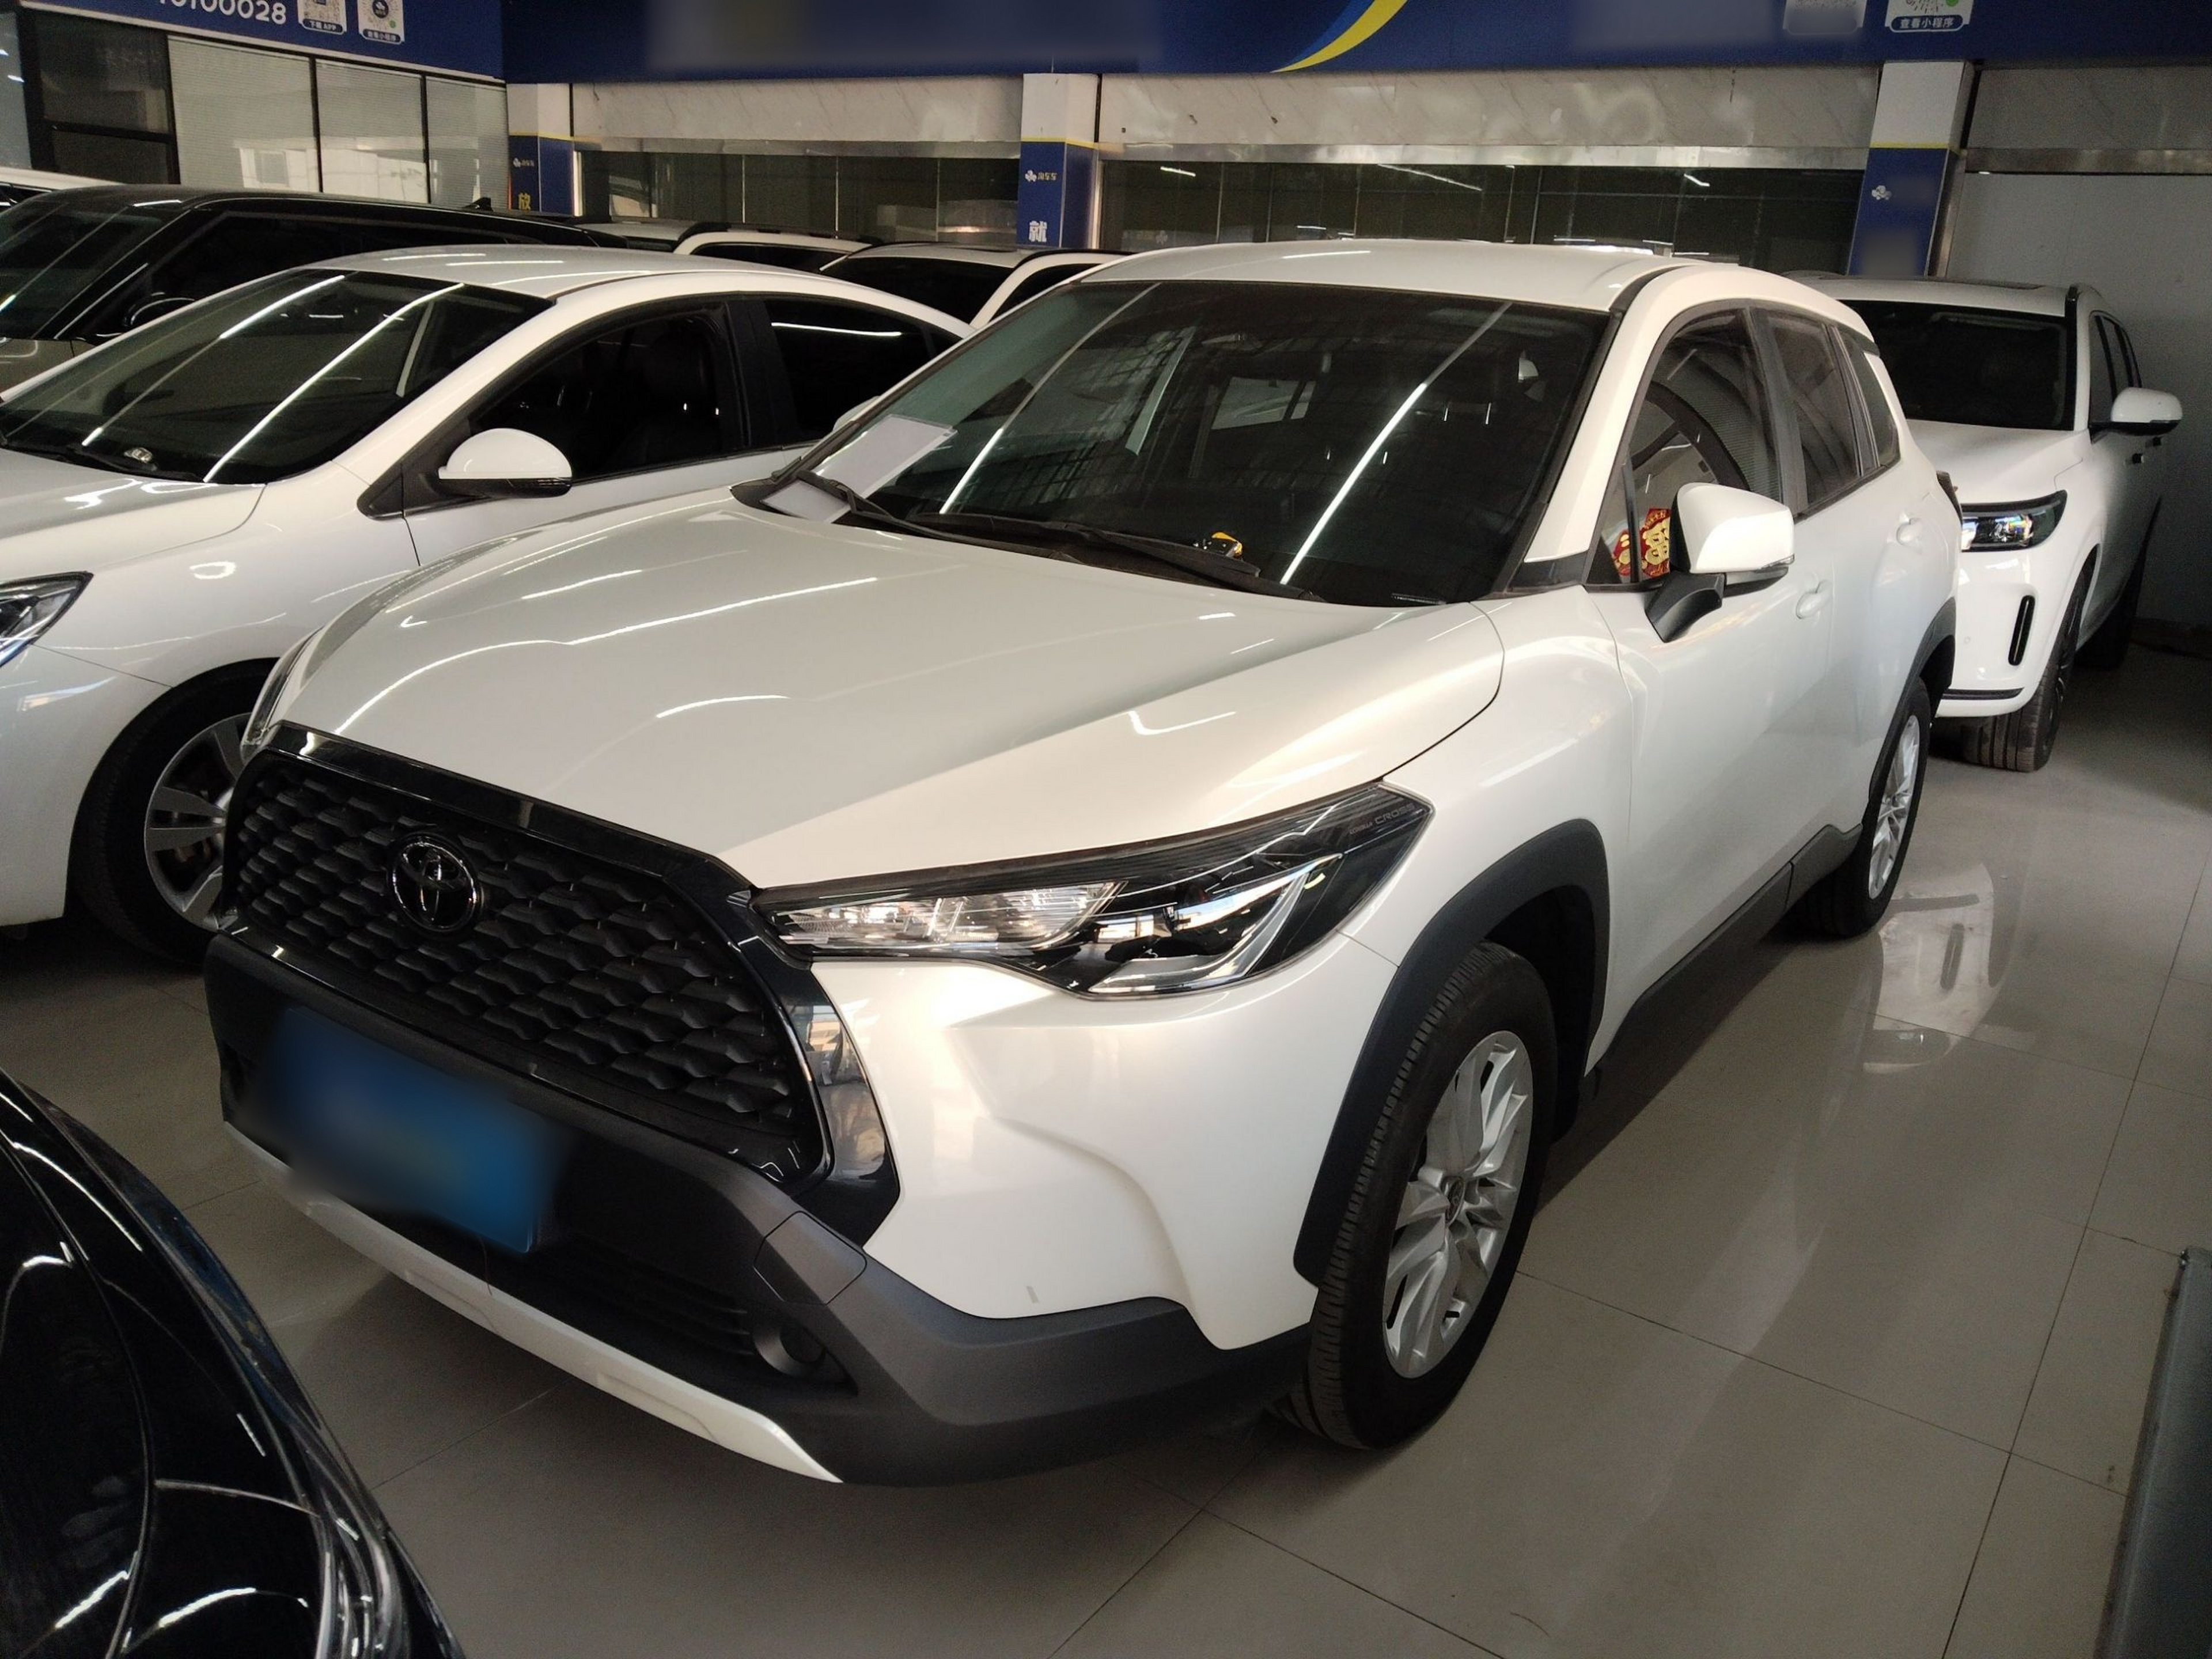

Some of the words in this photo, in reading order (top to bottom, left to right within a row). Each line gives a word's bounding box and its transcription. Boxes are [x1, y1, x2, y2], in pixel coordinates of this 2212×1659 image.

[160, 0, 286, 24] 00028
[1900, 17, 1954, 28] 查看小程序
[1029, 221, 1047, 242] 就
